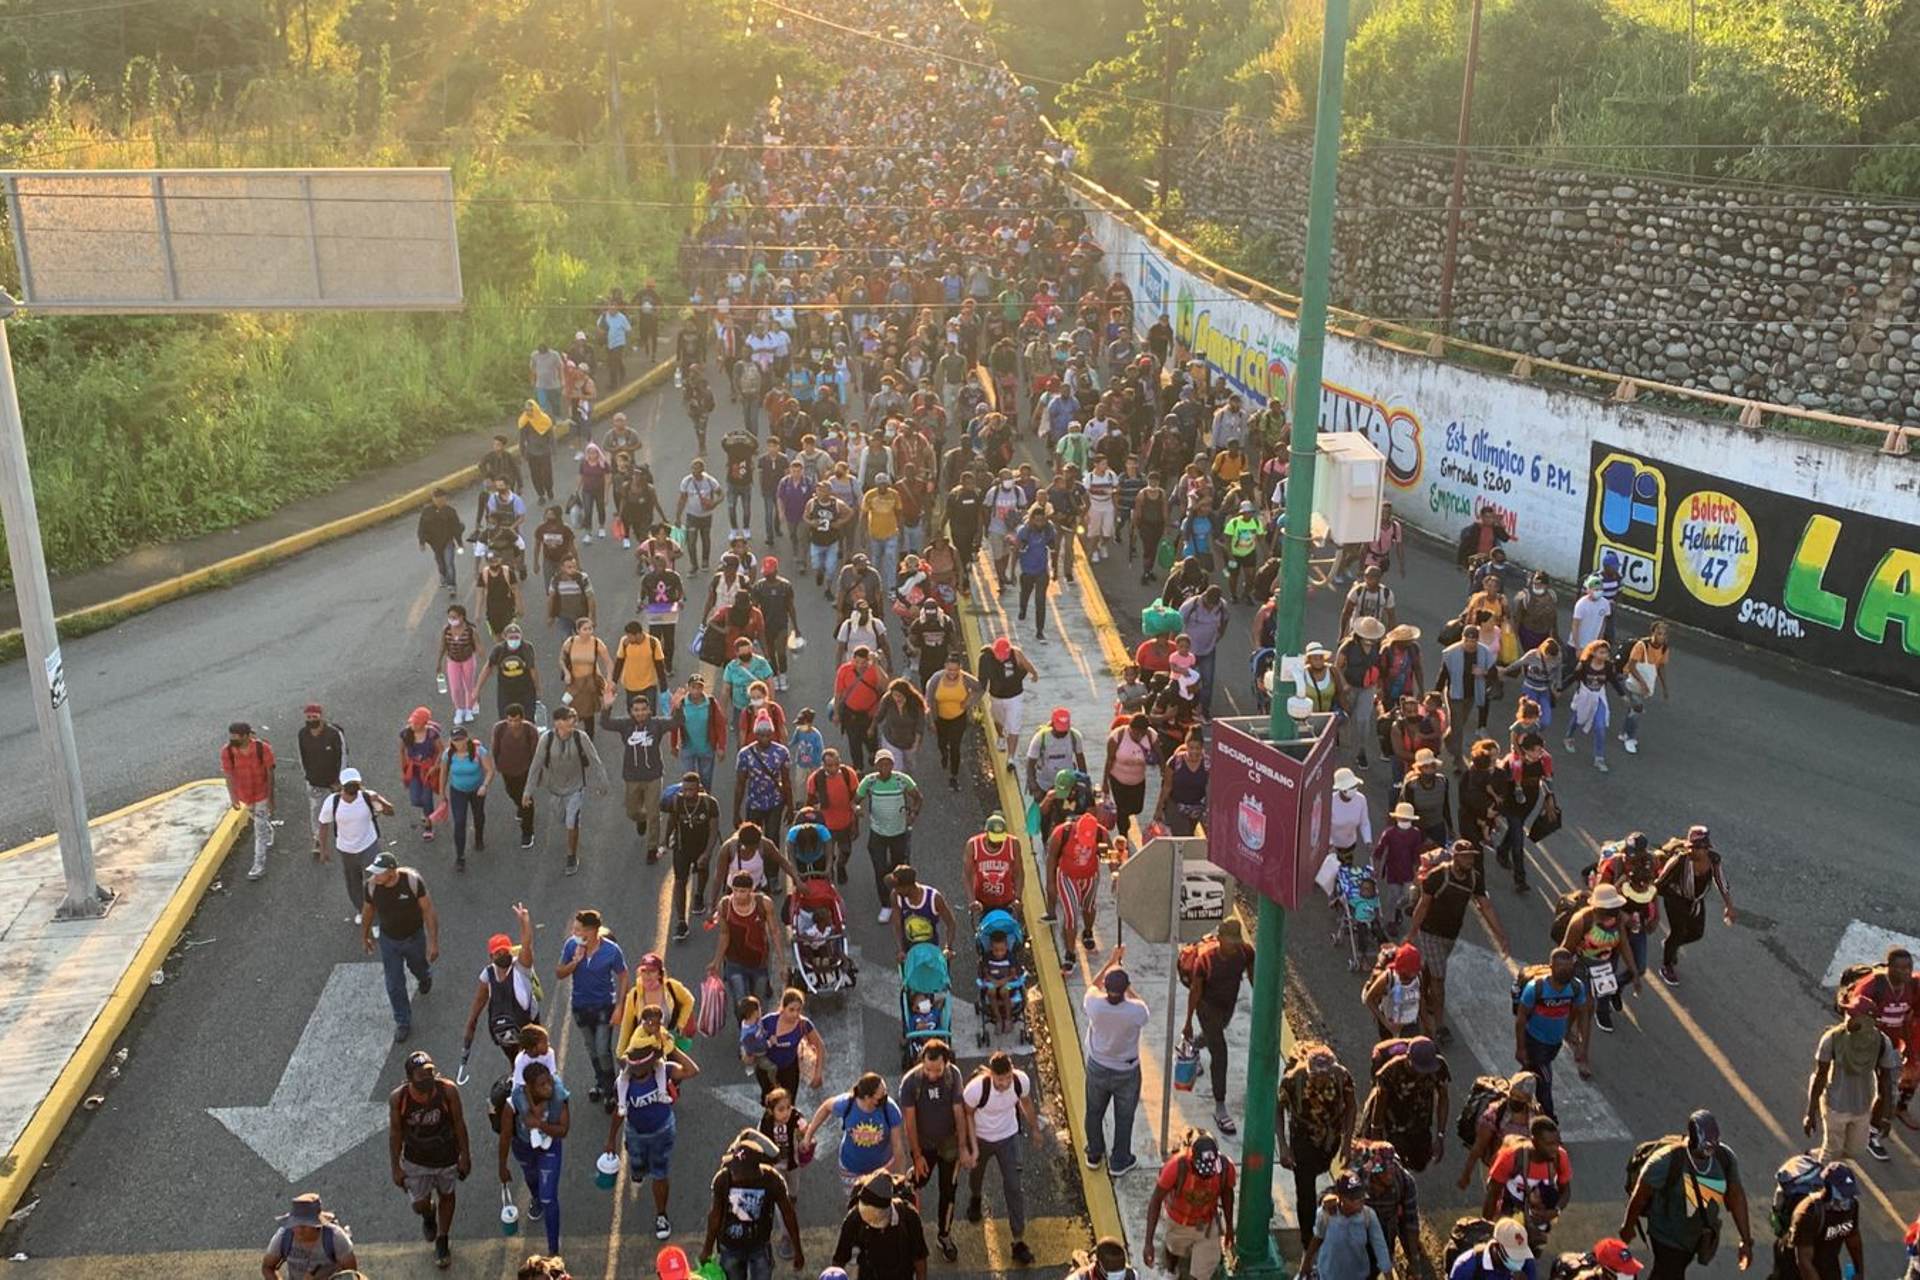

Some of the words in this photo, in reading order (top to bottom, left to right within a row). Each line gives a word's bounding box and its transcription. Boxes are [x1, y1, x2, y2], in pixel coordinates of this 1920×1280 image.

[1446, 422, 1469, 457] Est.
[1531, 455, 1542, 483] 6
[1546, 464, 1576, 495] P.M.
[1440, 457, 1478, 486] Entrada
[1483, 468, 1511, 494] $200
[1690, 495, 1737, 524] Boletos
[1700, 557, 1728, 588] 47
[1737, 598, 1777, 629] 9:30
[1217, 741, 1253, 767] ESCUDO
[1255, 761, 1294, 788] URBANO
[1248, 769, 1261, 784] CS
[630, 1089, 660, 1108] VAN
